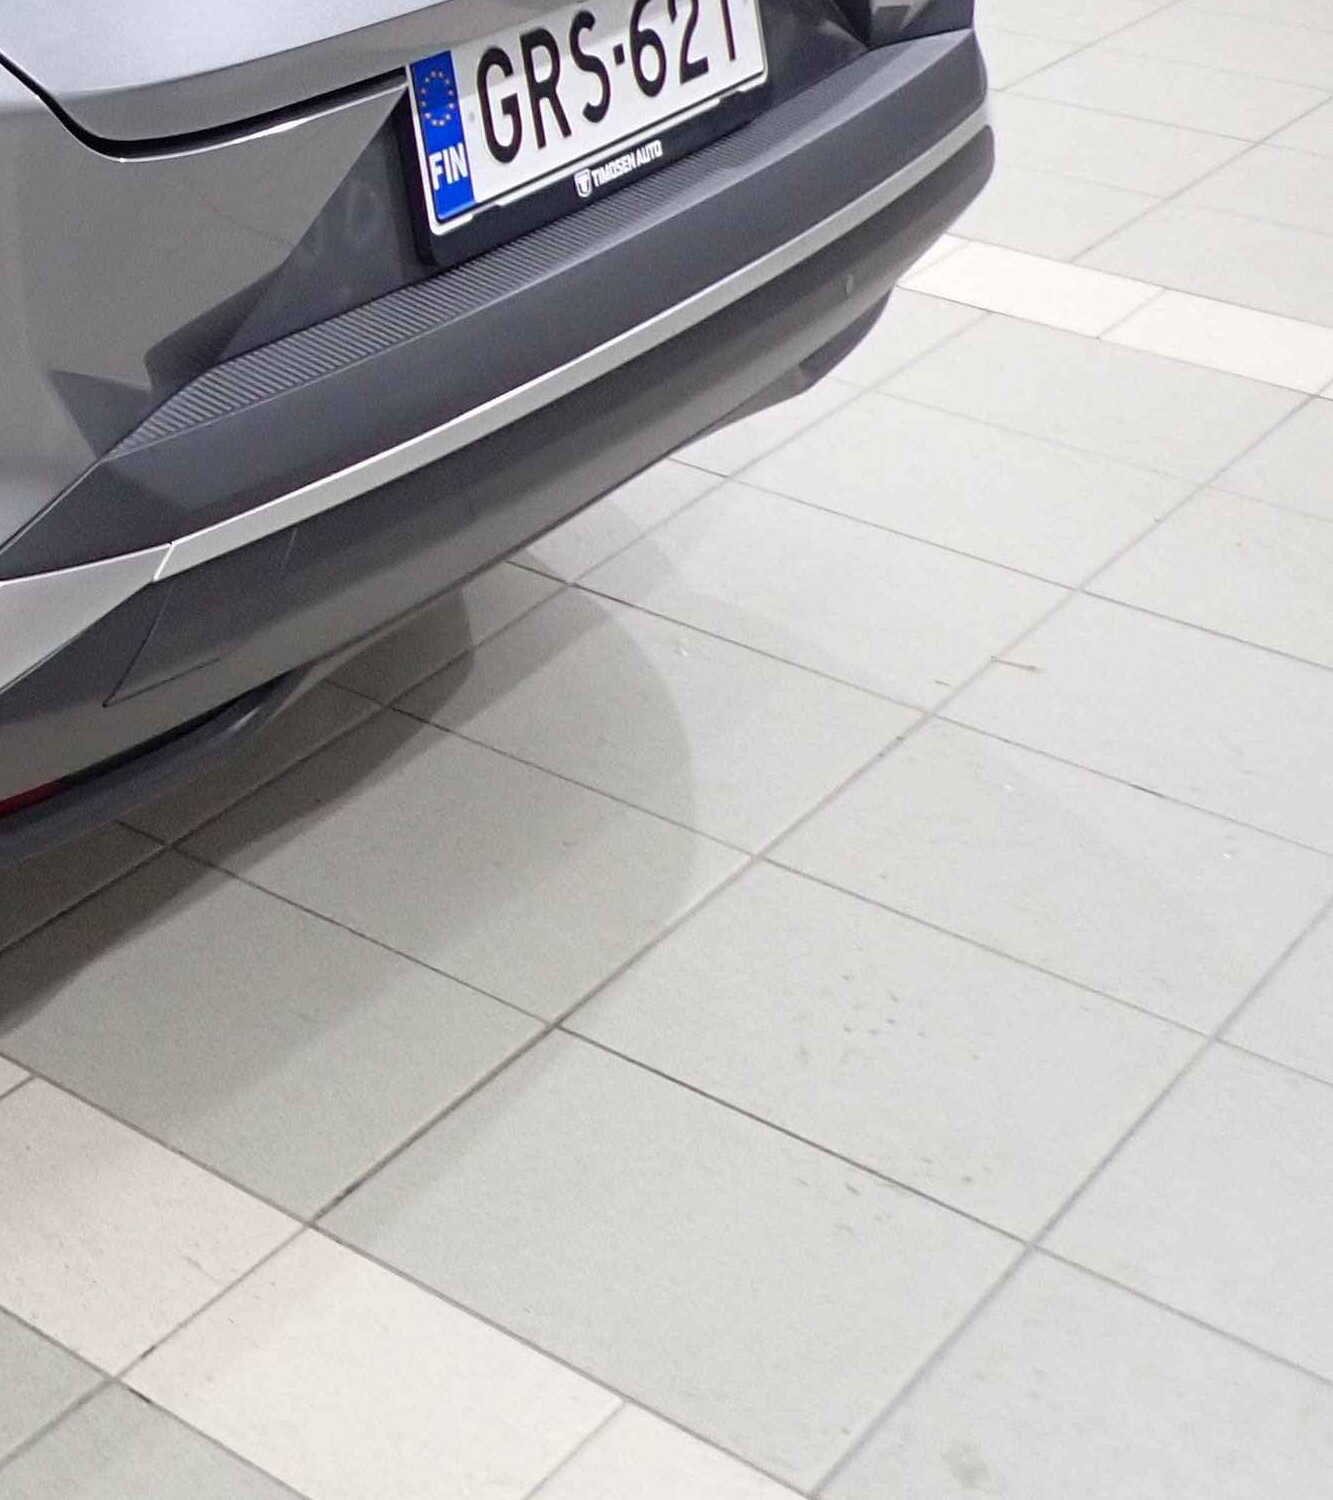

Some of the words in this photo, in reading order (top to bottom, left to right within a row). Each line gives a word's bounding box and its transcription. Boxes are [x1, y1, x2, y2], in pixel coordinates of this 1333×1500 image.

[428, 142, 469, 190] FIN
[591, 152, 637, 188] TIMOSEN
[636, 139, 663, 167] AUTO
